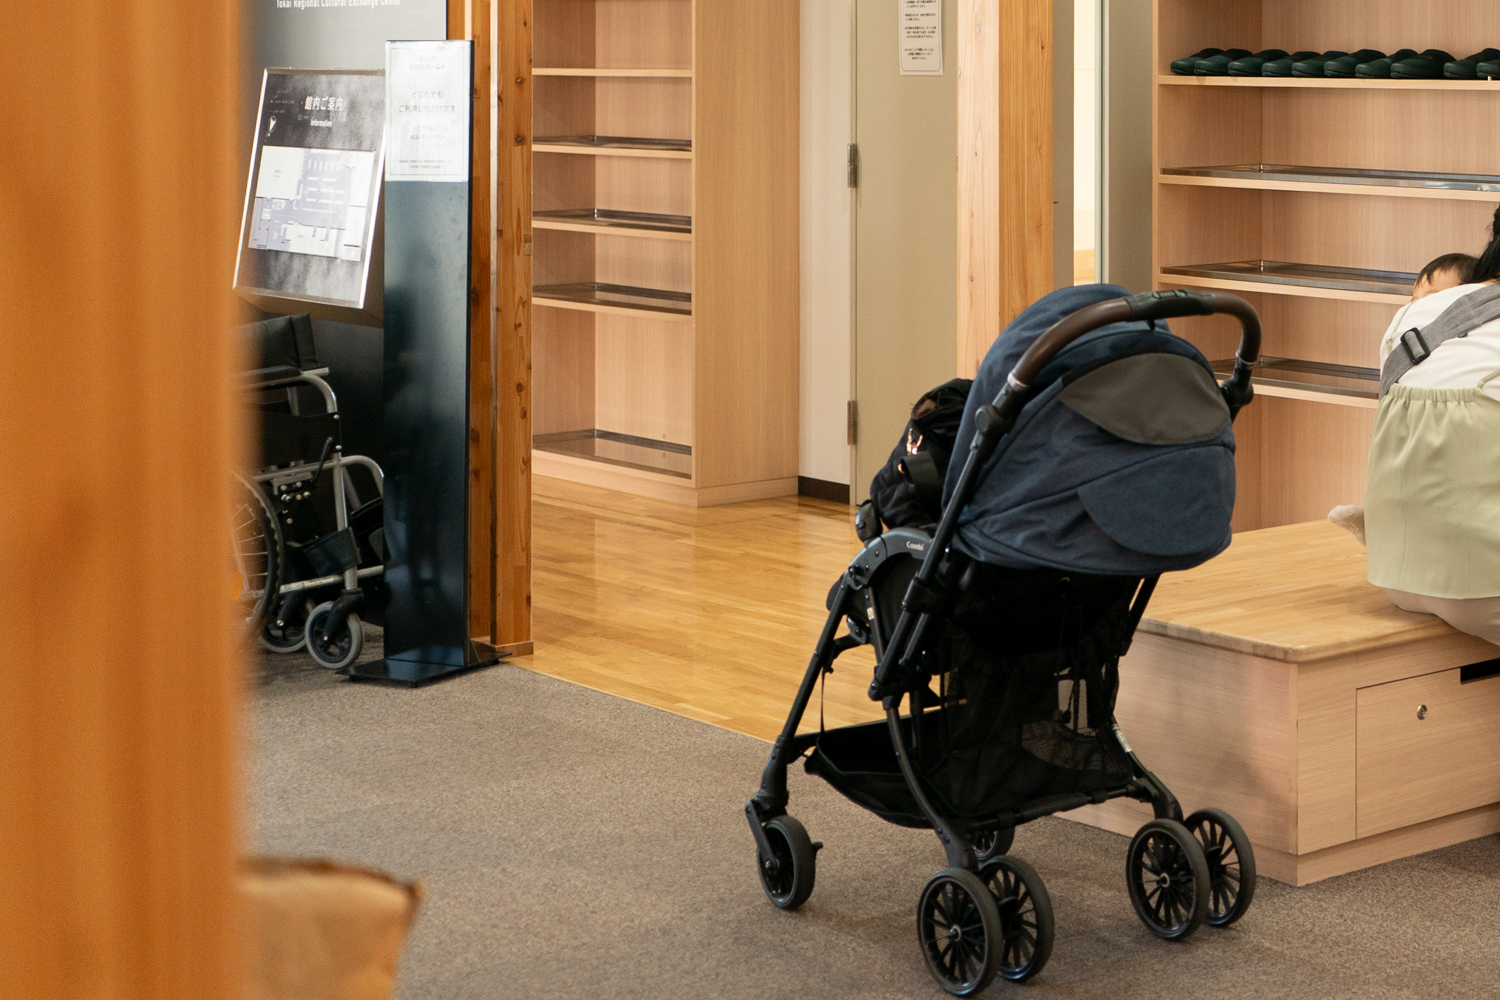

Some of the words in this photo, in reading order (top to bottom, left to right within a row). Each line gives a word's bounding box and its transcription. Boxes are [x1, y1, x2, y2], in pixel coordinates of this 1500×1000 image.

[304, 95, 344, 111] 館内ご案内
